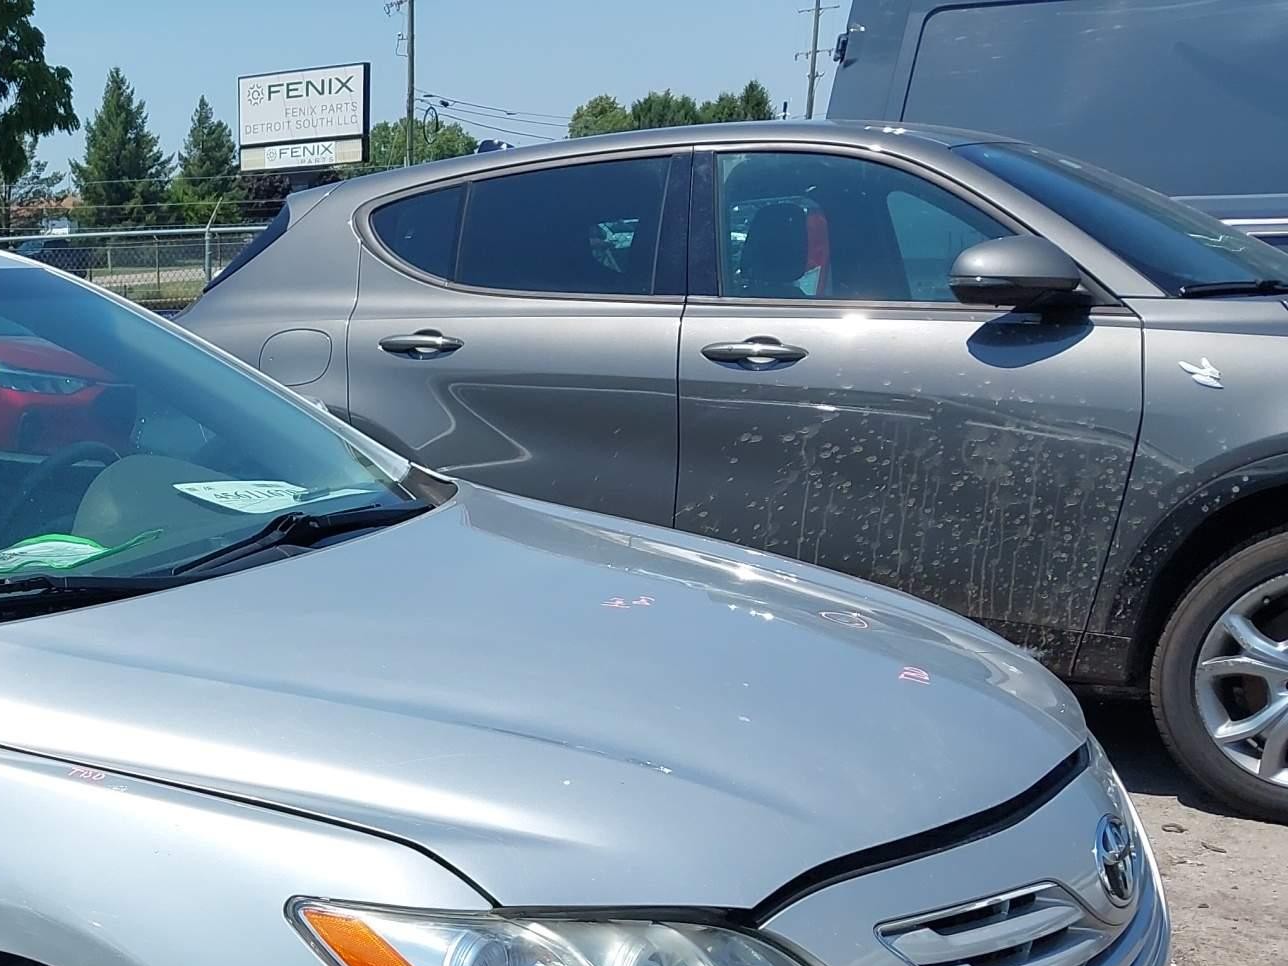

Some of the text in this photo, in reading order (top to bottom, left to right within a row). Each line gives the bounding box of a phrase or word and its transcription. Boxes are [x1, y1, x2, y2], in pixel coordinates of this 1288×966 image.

[267, 76, 354, 101] FENIX
[285, 101, 358, 118] FENIX PARTS
[245, 114, 358, 135] DETROIT SOUTH LLC
[279, 143, 334, 159] FENIX
[300, 156, 334, 164] PARTS
